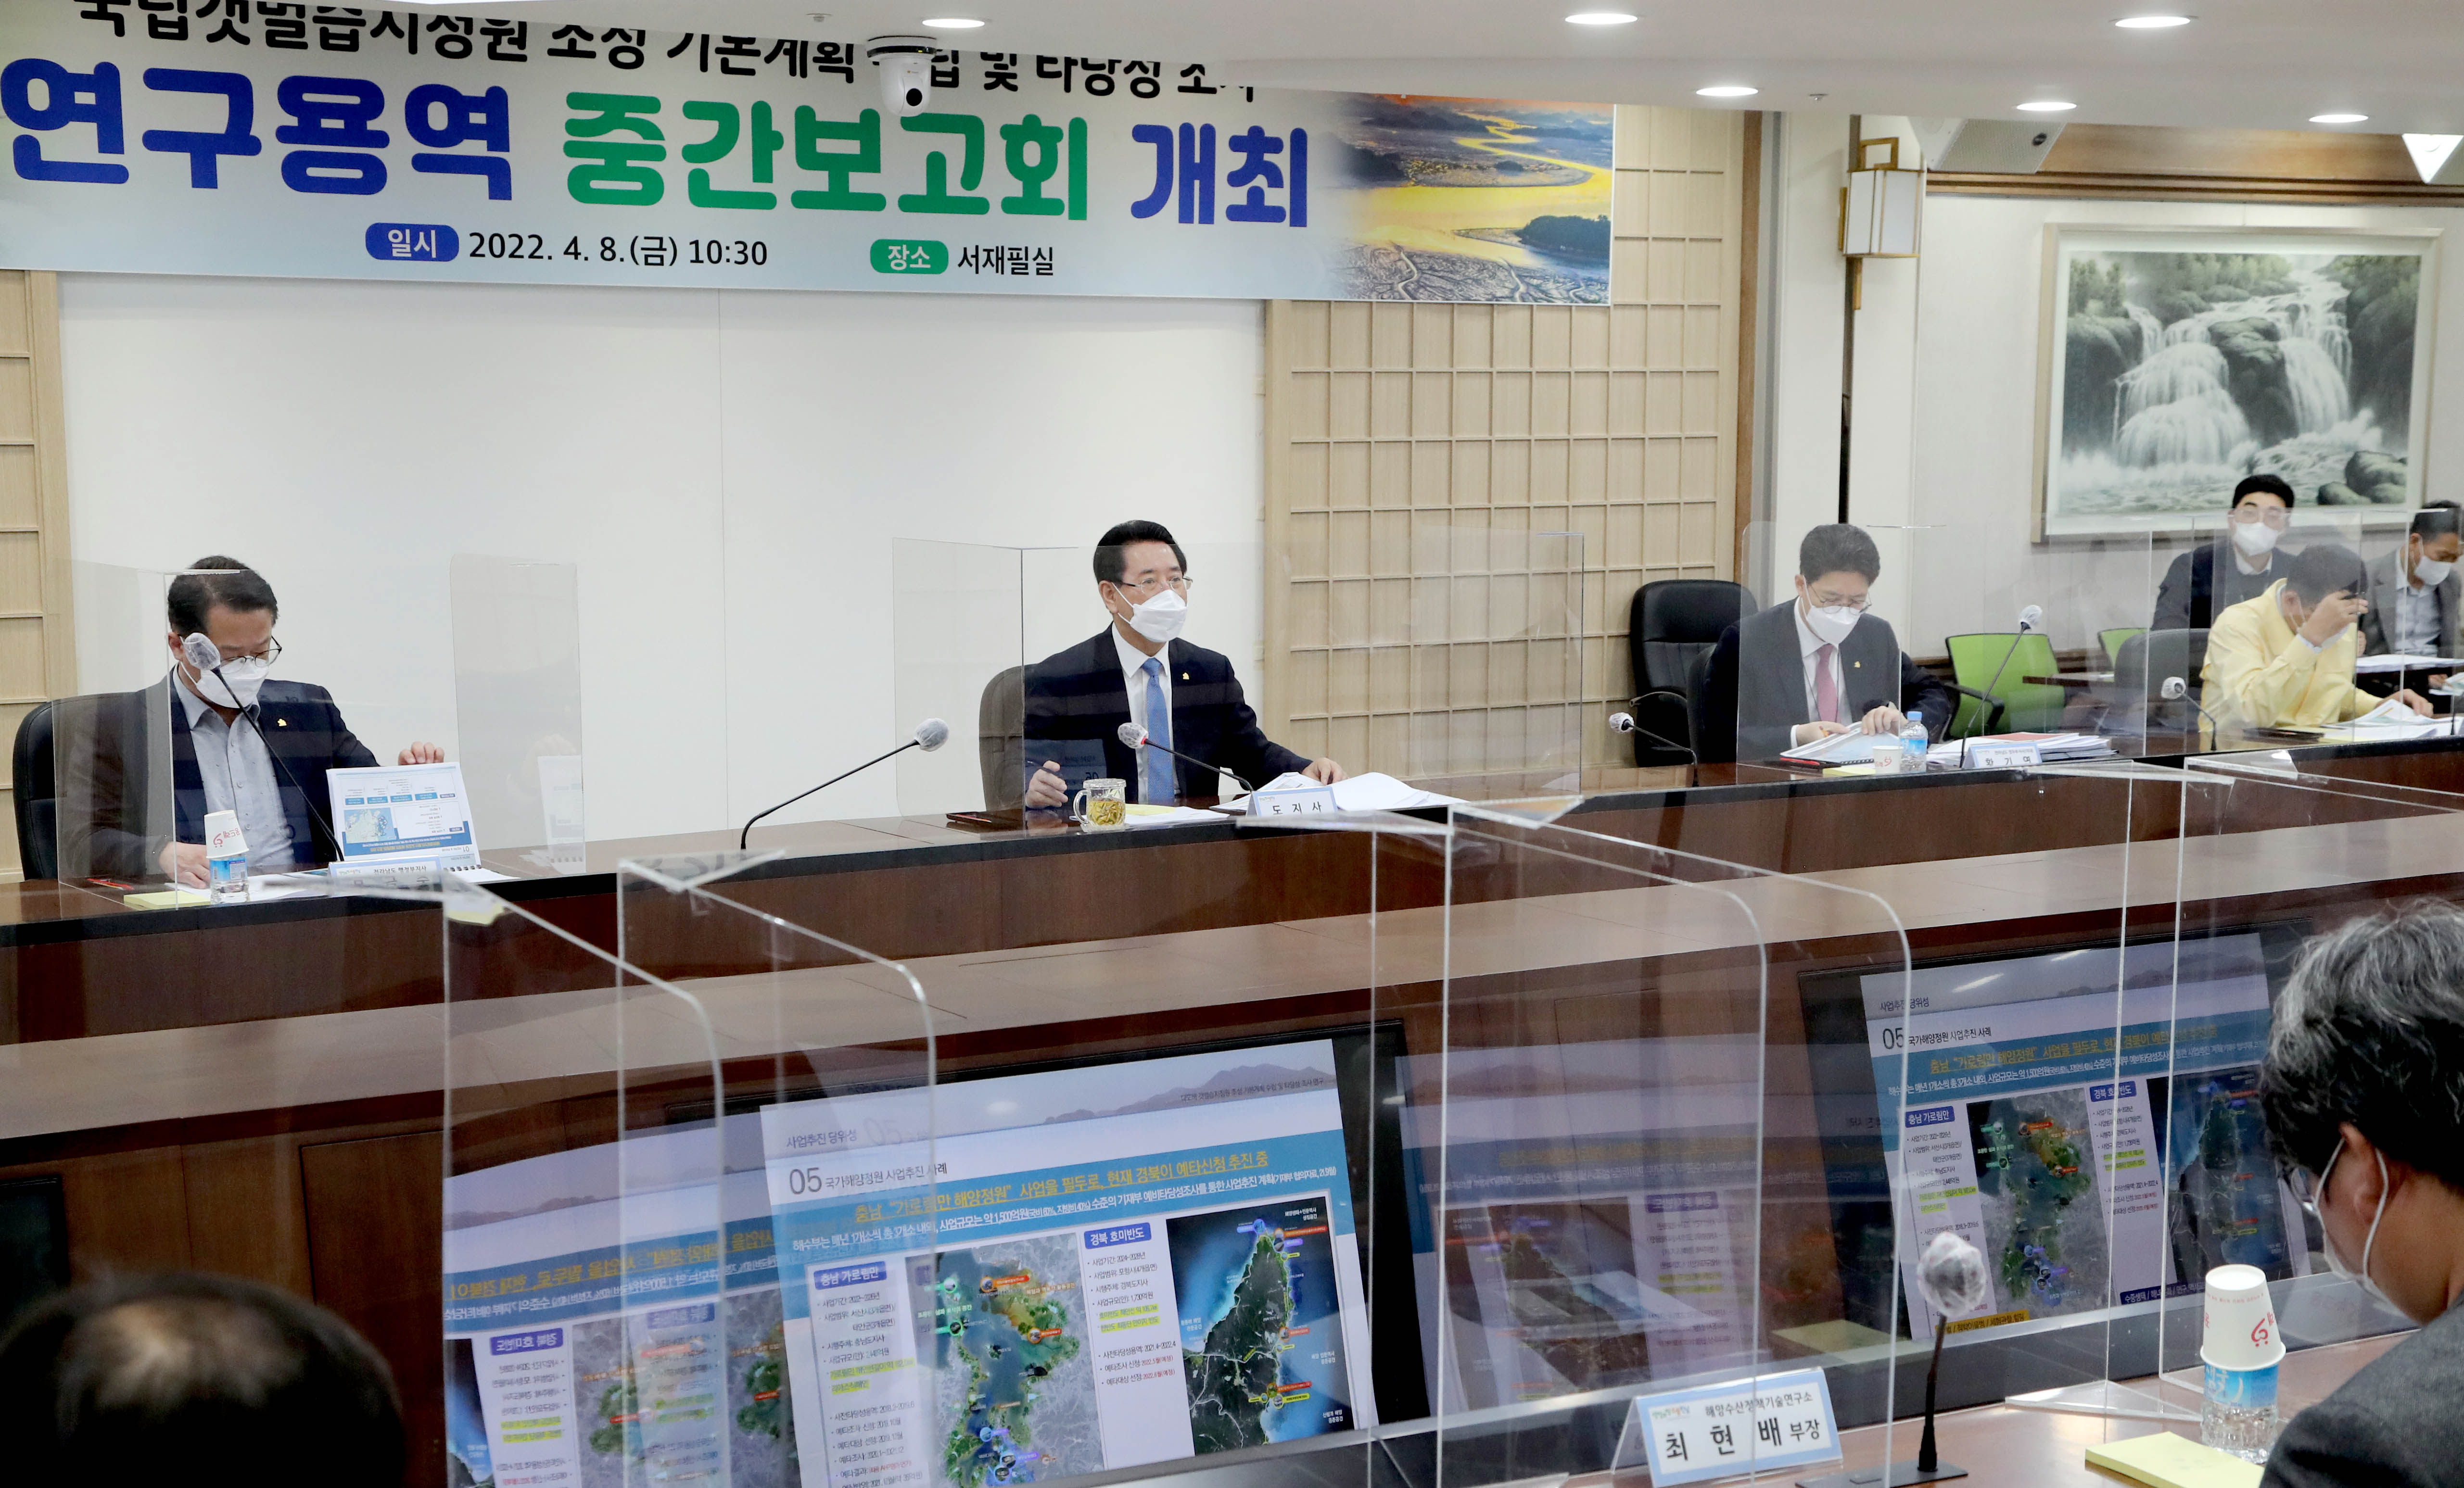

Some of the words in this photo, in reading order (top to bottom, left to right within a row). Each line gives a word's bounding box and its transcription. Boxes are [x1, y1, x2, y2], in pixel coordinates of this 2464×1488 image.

[0, 58, 512, 201] 연구용역
[563, 91, 1088, 220] 중간보고회
[1130, 122, 1308, 227] 개최
[388, 229, 438, 258] 일시
[469, 232, 553, 260] 2022.
[563, 235, 588, 261] 4.
[689, 240, 768, 265] 10:30
[888, 244, 931, 270] 장소
[958, 245, 1054, 276] 서재필실
[1883, 1028, 1904, 1049] 05
[1909, 1033, 1949, 1046] 국가해양정원
[1951, 1029, 1976, 1040] 사업추진
[1979, 1027, 1991, 1036] 사례
[1931, 1059, 1948, 1074] 충남
[2044, 1043, 2069, 1057] 사업을
[2124, 1034, 2148, 1048] 경북이
[1988, 1071, 2018, 1083] 사업규모는
[2094, 1058, 2110, 1069] 수준의
[2094, 1089, 2106, 1099] 경북
[1909, 1114, 1921, 1124] 충남
[1924, 1110, 1949, 1122] 가로림만
[786, 1133, 826, 1148] 사업추진
[828, 1129, 857, 1144] 당위성
[789, 1167, 822, 1195] 05
[826, 1172, 883, 1188] 국가해양정원
[886, 1166, 924, 1181] 사업추진
[856, 1204, 882, 1222] 충남
[1020, 1178, 1058, 1198] 사업을
[1062, 1173, 1104, 1191] 필두로,
[1107, 1169, 1132, 1186] 현재
[1136, 1163, 1172, 1182] 경북이
[1177, 1156, 1226, 1178] 예타신청
[1228, 1153, 1254, 1169] 추진
[1257, 1151, 1269, 1168] 중
[793, 1236, 830, 1251] 해수부는
[940, 1215, 983, 1232] 사업규모는
[983, 1212, 993, 1225] 약
[1092, 1195, 1116, 1210] 수준의
[1118, 1191, 1142, 1206] 기재부
[1144, 1184, 1207, 1202] 예비타당성조사를
[1208, 1180, 1225, 1194] 통한
[1226, 1175, 1257, 1190] 사업추진
[1091, 1232, 1107, 1246] 경북
[1110, 1227, 1144, 1242] 호미반도
[1092, 1257, 1116, 1266] 사업기간:
[821, 1273, 839, 1286] 충남
[842, 1266, 879, 1283] 가로림만
[1094, 1270, 1117, 1279] 사업범위:
[1121, 1279, 1148, 1289] 경북도지사
[1105, 1362, 1127, 1372] 예타조사
[1107, 1376, 1129, 1386] 예타대상
[1705, 1391, 1813, 1417] 해양수산정책기술연구소
[1790, 1419, 1820, 1441] 부장
